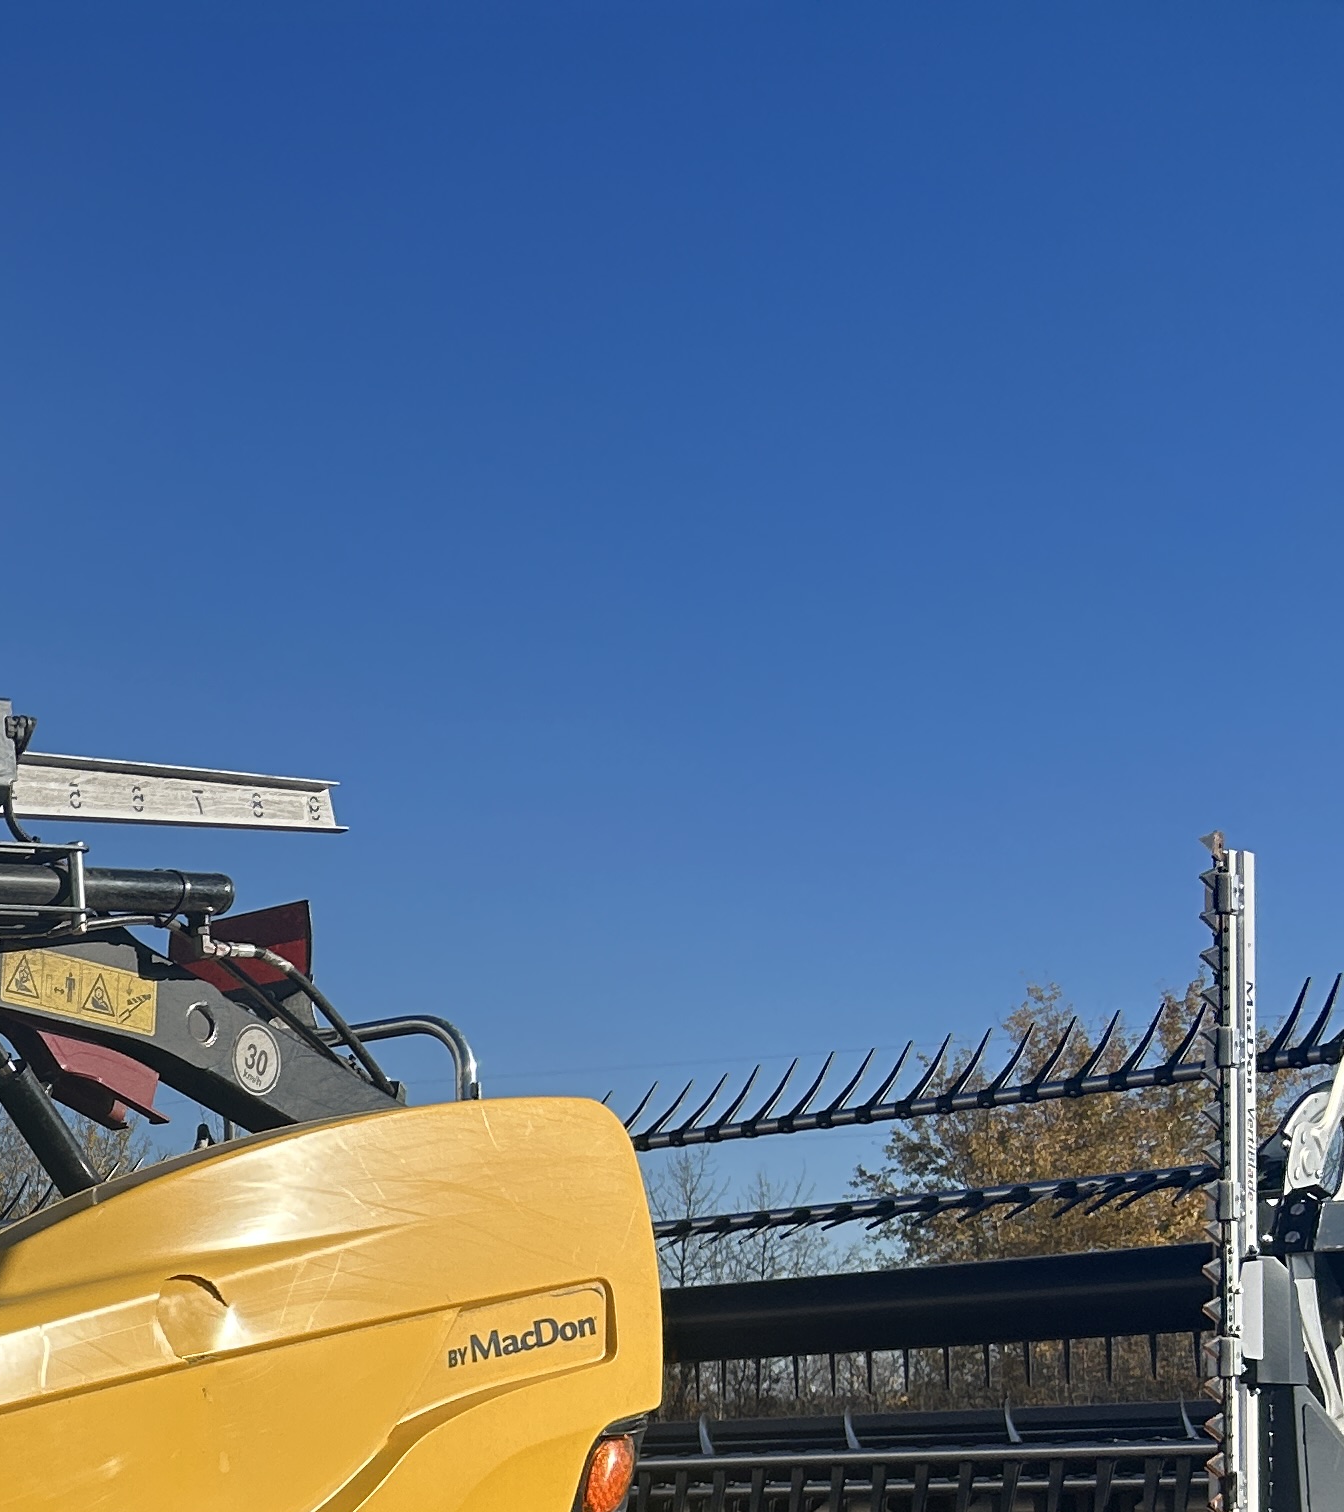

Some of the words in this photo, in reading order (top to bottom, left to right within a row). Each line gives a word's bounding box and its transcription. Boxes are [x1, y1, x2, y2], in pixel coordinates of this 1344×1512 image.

[191, 789, 204, 816] 7
[251, 792, 264, 818] 8
[244, 1043, 268, 1077] 30
[448, 1346, 468, 1368] BY
[470, 1315, 597, 1363] MacDon
